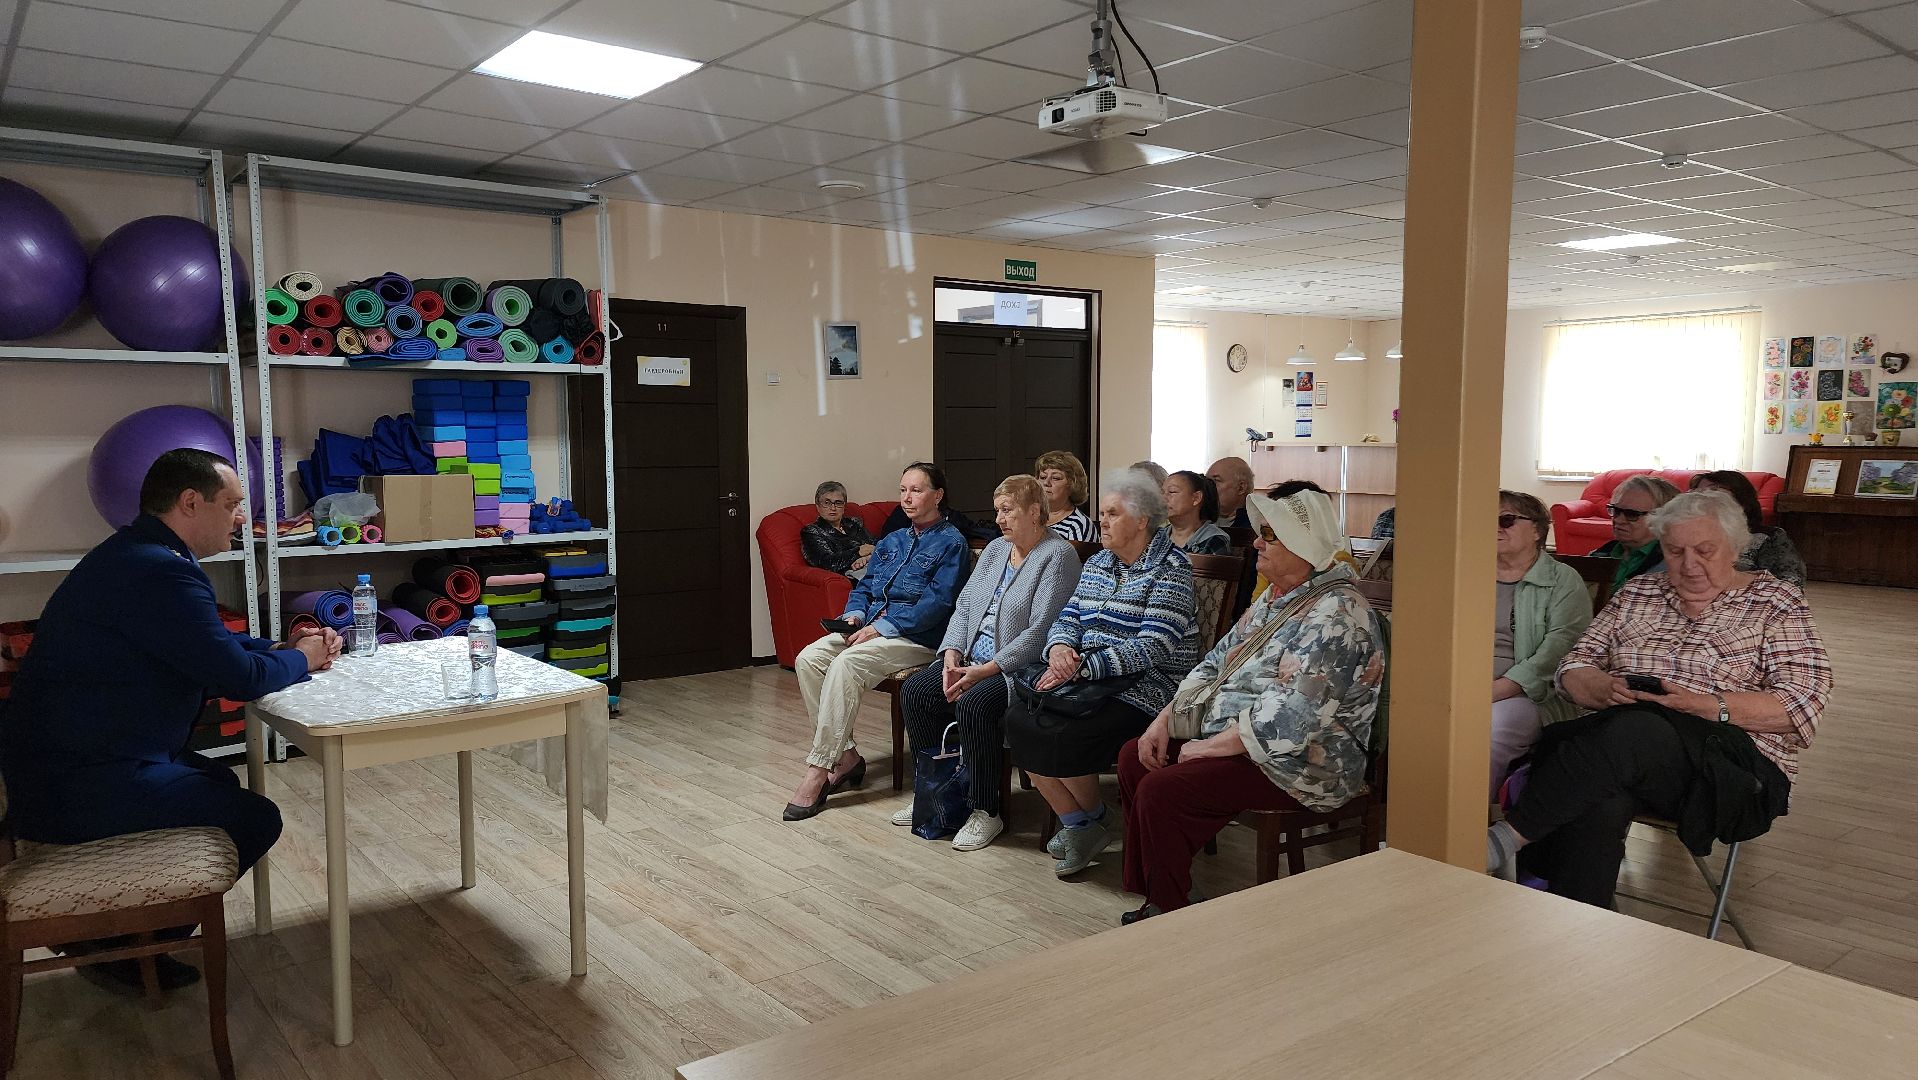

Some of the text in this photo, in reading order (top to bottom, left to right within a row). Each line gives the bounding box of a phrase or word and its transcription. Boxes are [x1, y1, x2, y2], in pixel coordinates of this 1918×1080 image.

[1006, 264, 1035, 279] ВЫХОД
[657, 323, 667, 332] 11
[1013, 330, 1020, 338] 12
